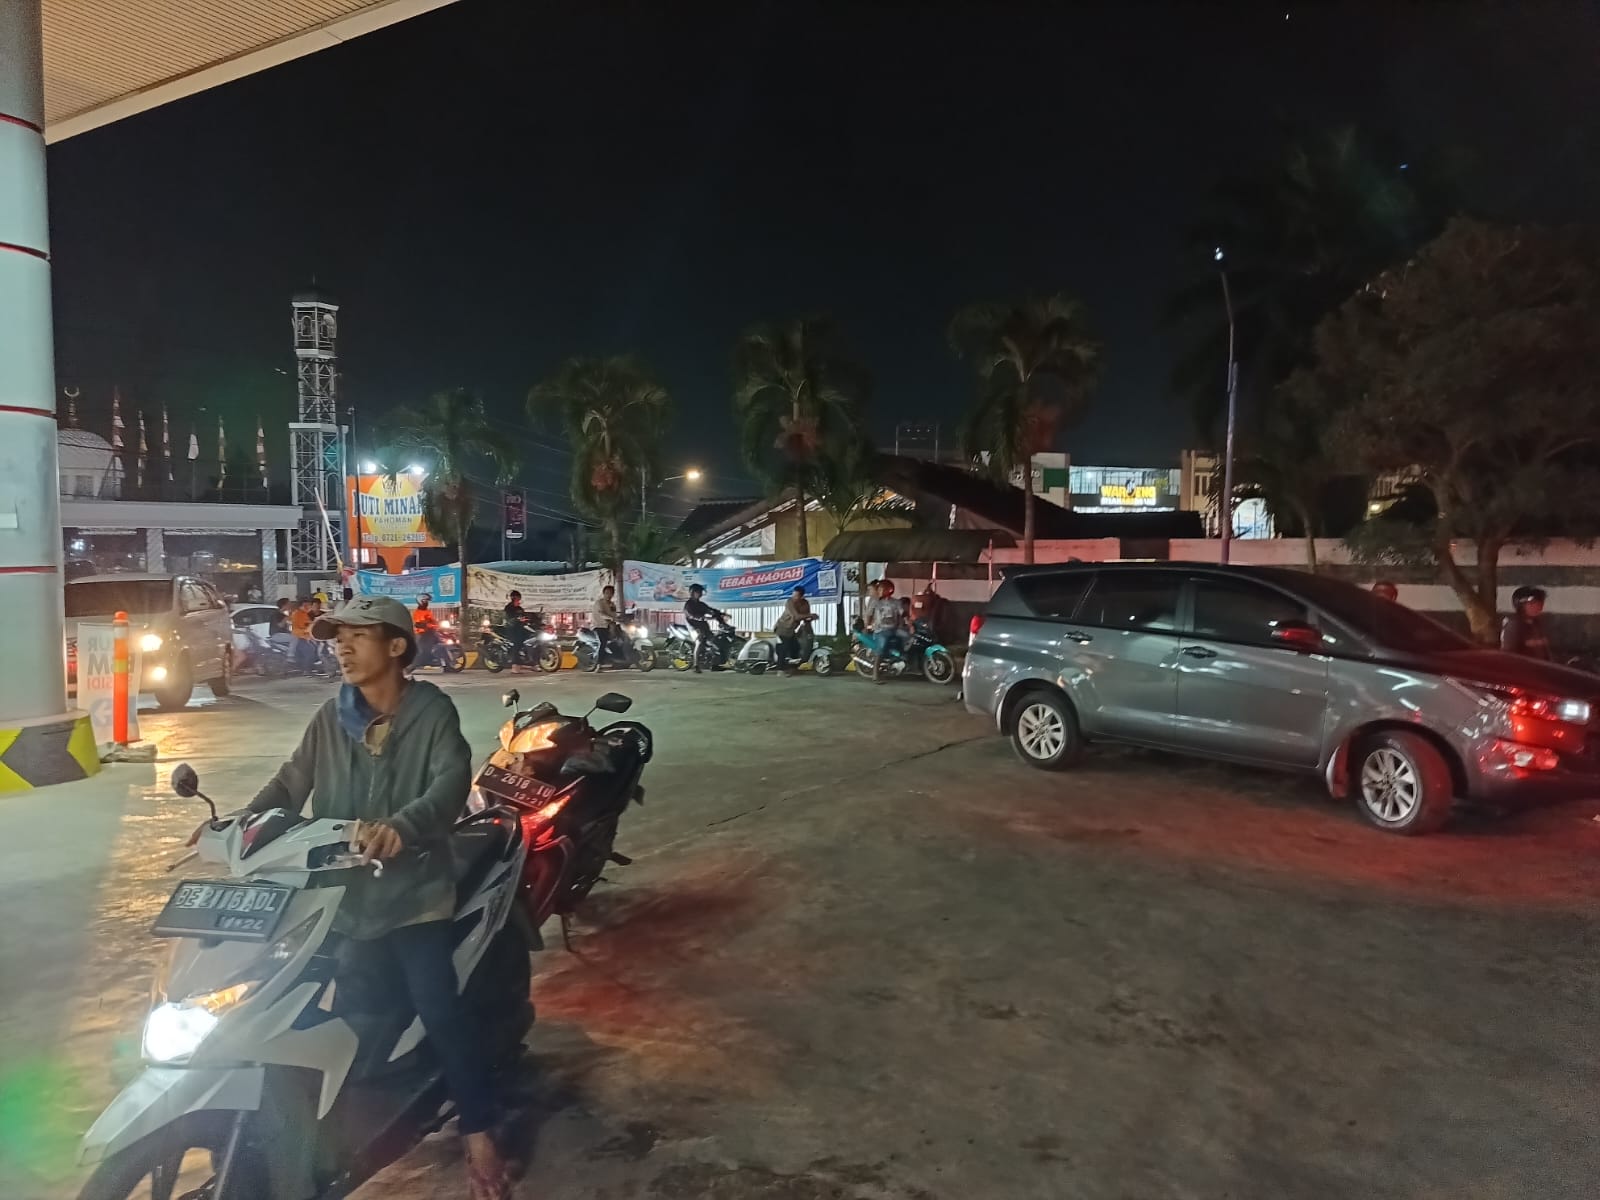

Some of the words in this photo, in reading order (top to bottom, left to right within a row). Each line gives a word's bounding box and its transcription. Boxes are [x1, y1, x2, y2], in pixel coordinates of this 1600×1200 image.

[720, 576, 753, 588] TEBAR
[755, 568, 802, 584] HADIAH
[501, 773, 531, 790] 2618
